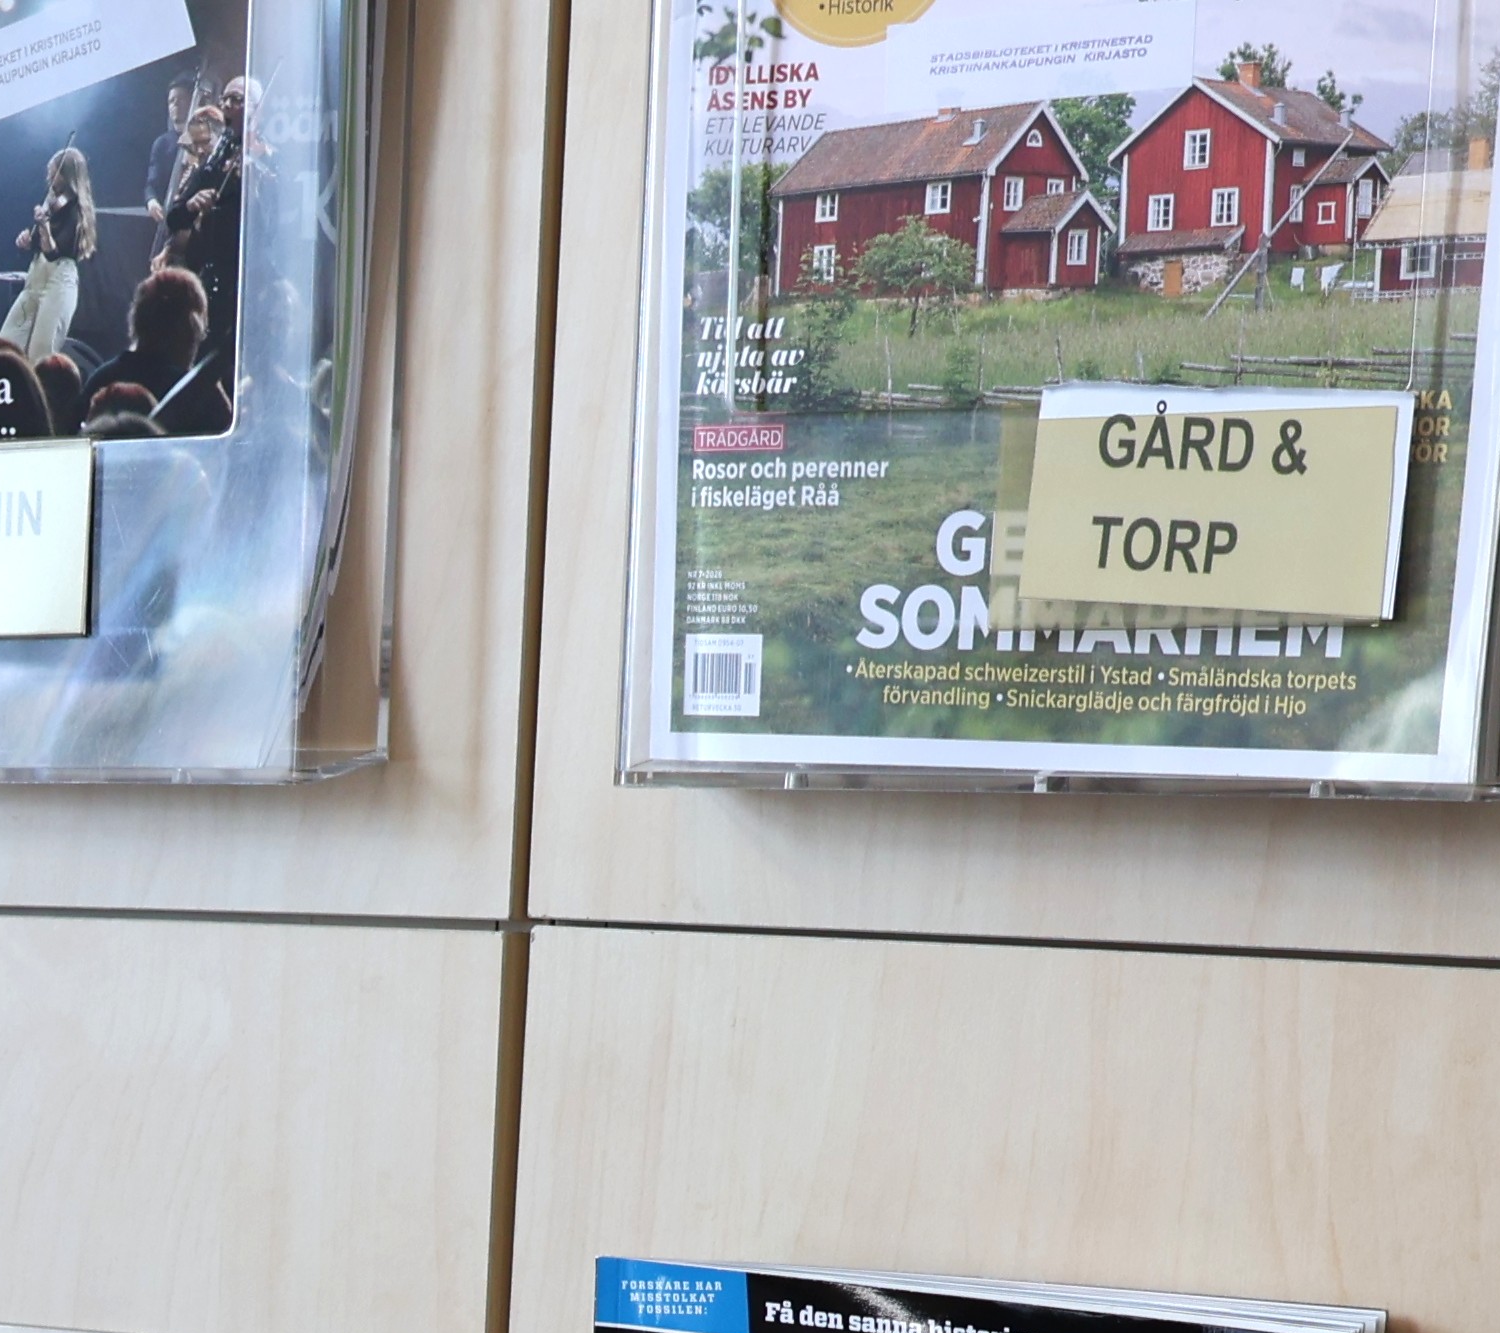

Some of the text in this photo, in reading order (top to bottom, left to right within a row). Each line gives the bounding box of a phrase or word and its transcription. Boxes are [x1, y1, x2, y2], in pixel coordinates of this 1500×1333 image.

[698, 427, 782, 449] TRÄDGÅRD
[1099, 400, 1308, 476] GÅRD &
[693, 460, 889, 484] Rosor och perenner
[691, 481, 840, 511] i fiskeläget Råå
[1091, 516, 1238, 574] TORP
[856, 657, 960, 685] Återskapad
[965, 661, 1083, 685] schweizerstil
[1099, 664, 1152, 687] Ystad
[1169, 666, 1281, 689] Småländska
[1286, 671, 1356, 694] torpets
[883, 687, 990, 710] förvandling
[1007, 689, 1134, 715] Snickarglädje
[1139, 692, 1172, 712] och
[1177, 692, 1260, 717] färgfröjd
[1274, 695, 1306, 718] Hjo
[765, 1299, 795, 1325] Få
[800, 1304, 842, 1330] den
